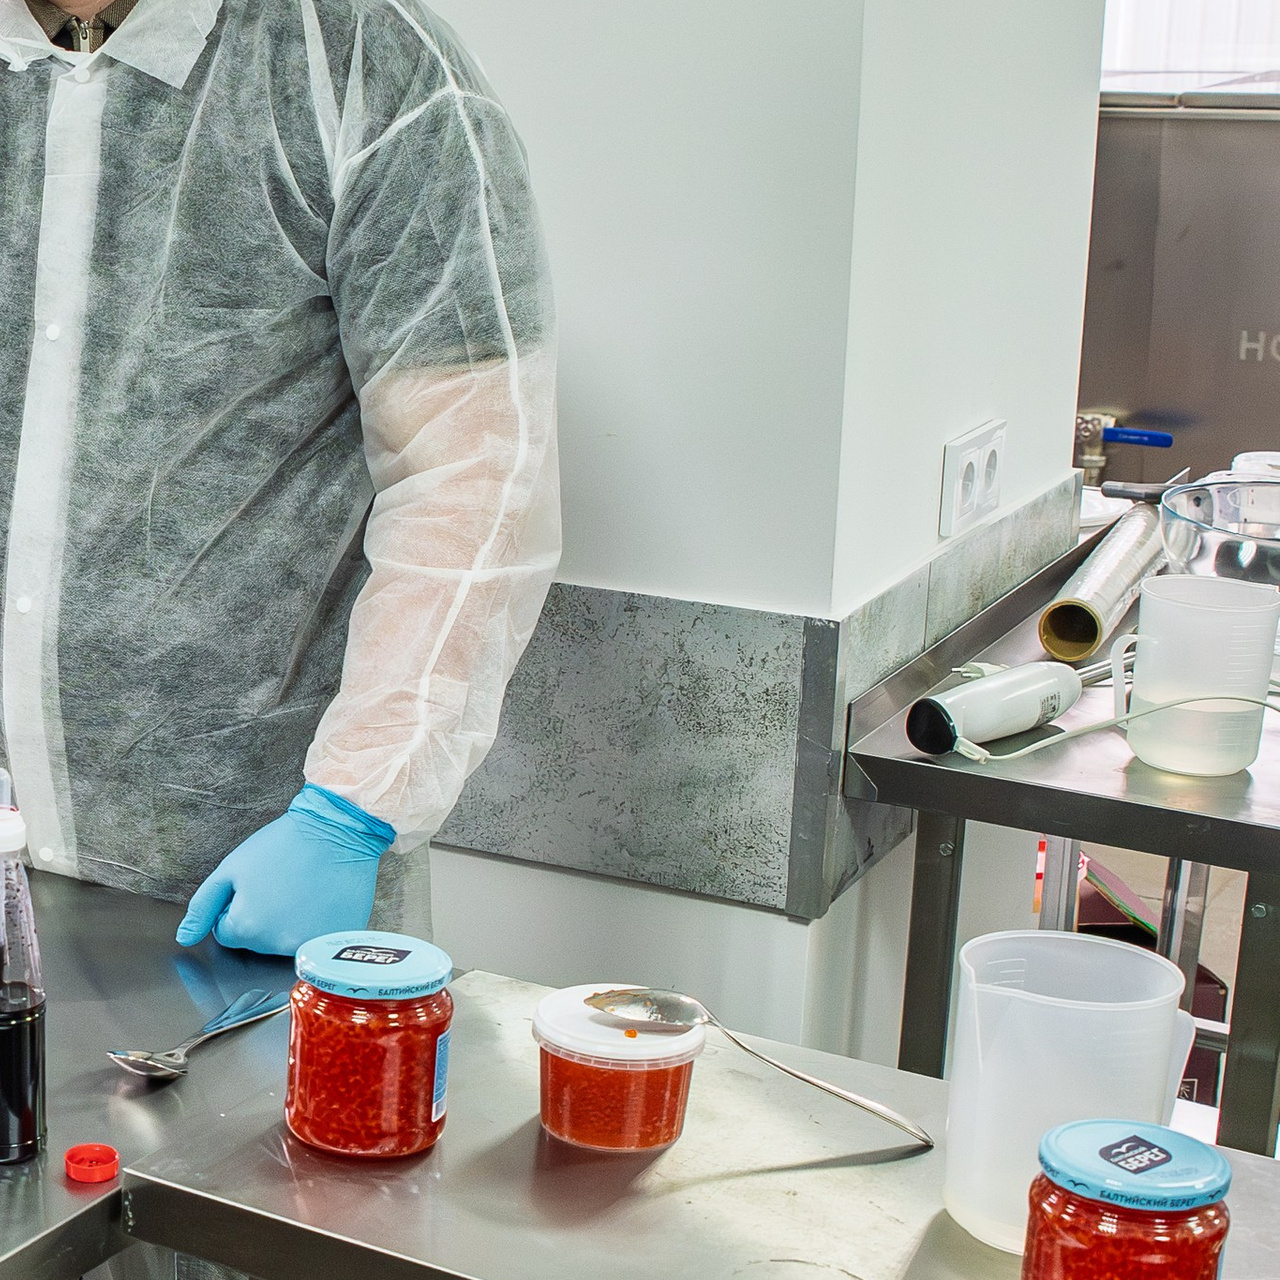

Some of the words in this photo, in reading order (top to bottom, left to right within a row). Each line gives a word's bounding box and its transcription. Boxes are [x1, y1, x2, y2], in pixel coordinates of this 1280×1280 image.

[339, 951, 400, 964] БЕРЕГ
[378, 982, 429, 996] БАЛТИЙСКИЙ
[1116, 1147, 1167, 1171] БЕРЕГ
[1099, 1190, 1168, 1207] БАЛТИЙСКИЙ
[1169, 1196, 1196, 1208] БЕРЕГ
